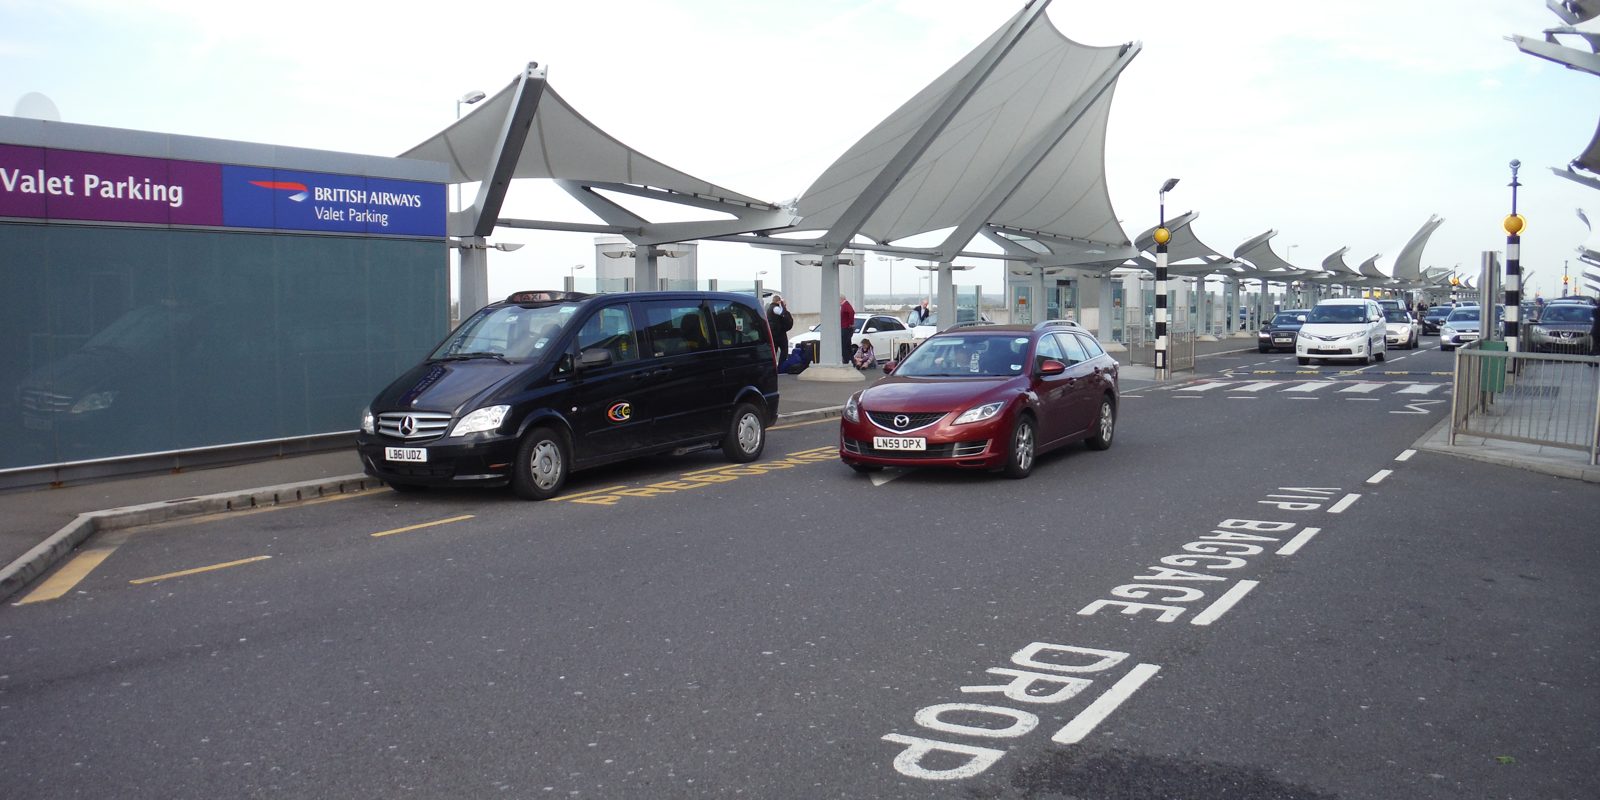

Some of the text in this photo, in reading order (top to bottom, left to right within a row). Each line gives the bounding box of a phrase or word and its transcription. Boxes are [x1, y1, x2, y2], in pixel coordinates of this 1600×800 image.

[0, 168, 184, 208] Valet Parking
[314, 187, 422, 208] BRITISH AIRWAYS
[314, 206, 389, 226] Valet Parking
[876, 438, 922, 449] LN59 OPX
[388, 449, 422, 460] LB61 UDZ
[880, 486, 1343, 781] VIP BAGGAGE DROP
